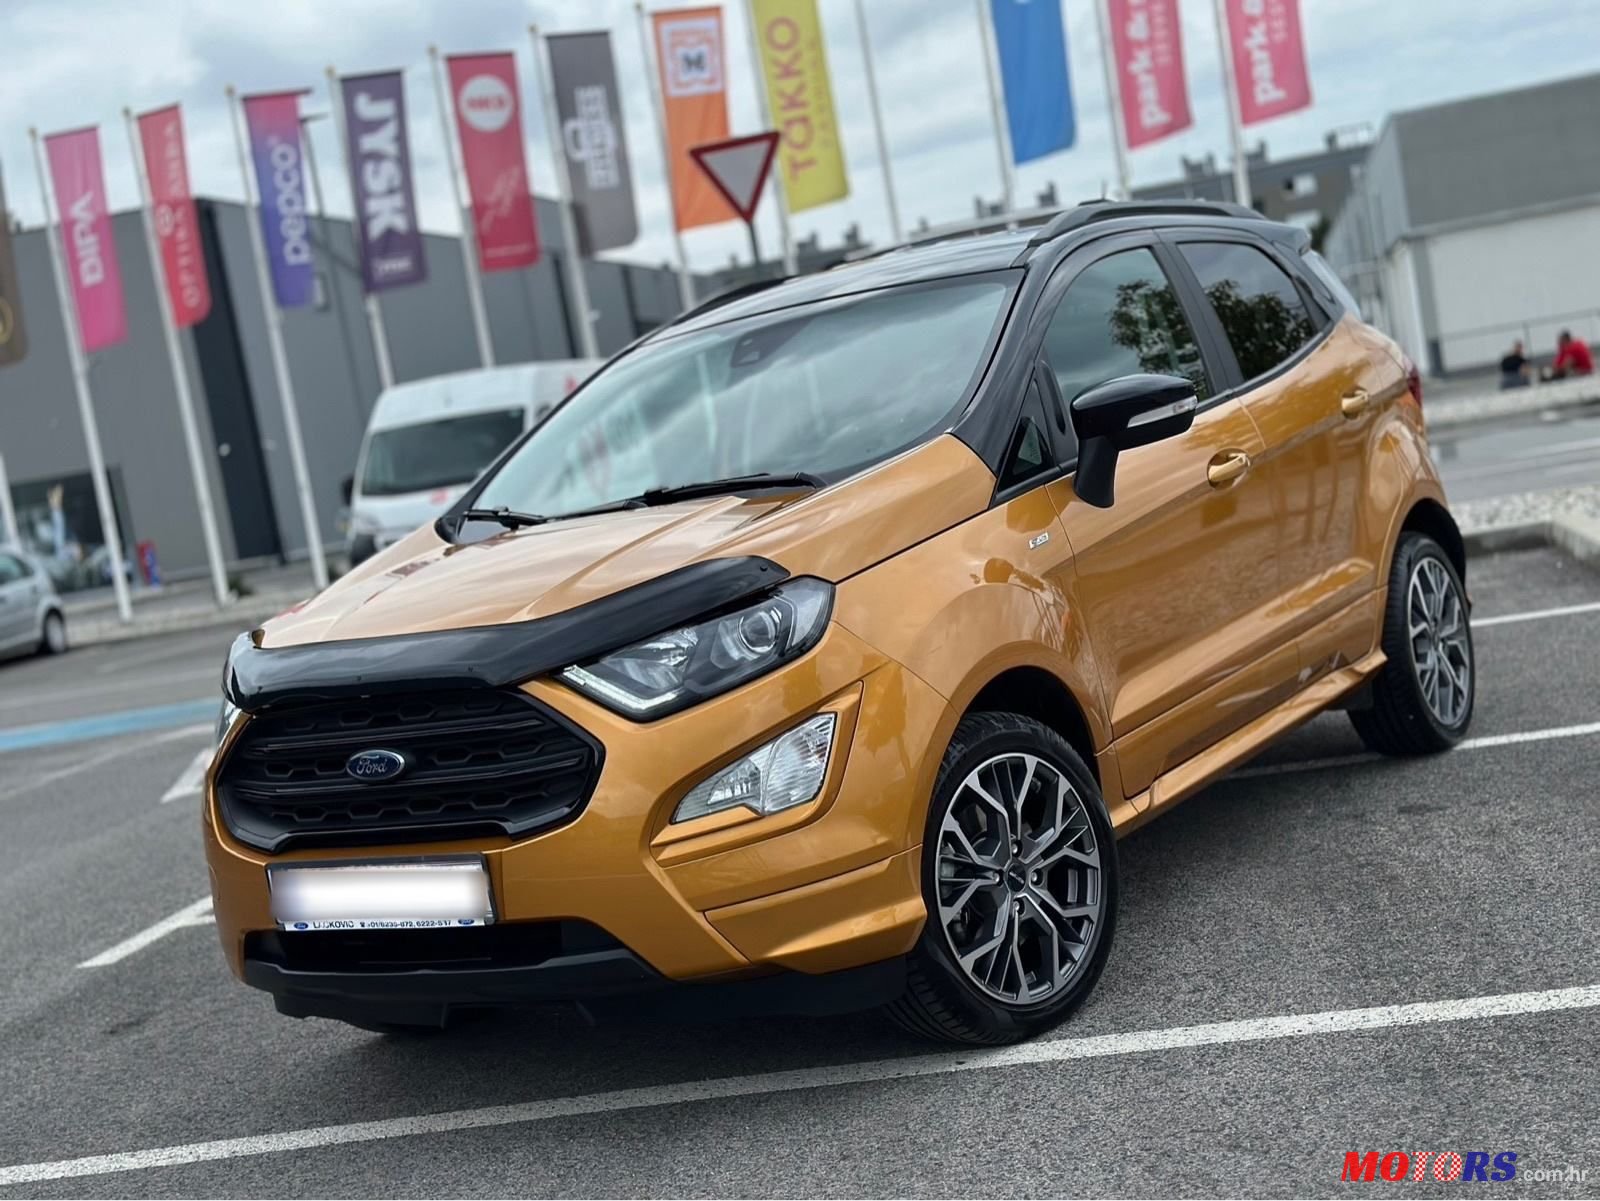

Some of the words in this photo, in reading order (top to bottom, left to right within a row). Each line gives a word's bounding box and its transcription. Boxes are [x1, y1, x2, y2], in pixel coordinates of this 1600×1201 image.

[1127, 51, 1173, 130] park
[1243, 24, 1288, 106] park
[270, 143, 311, 266] pepco
[354, 93, 410, 240] JYSK
[356, 755, 388, 774] Ford
